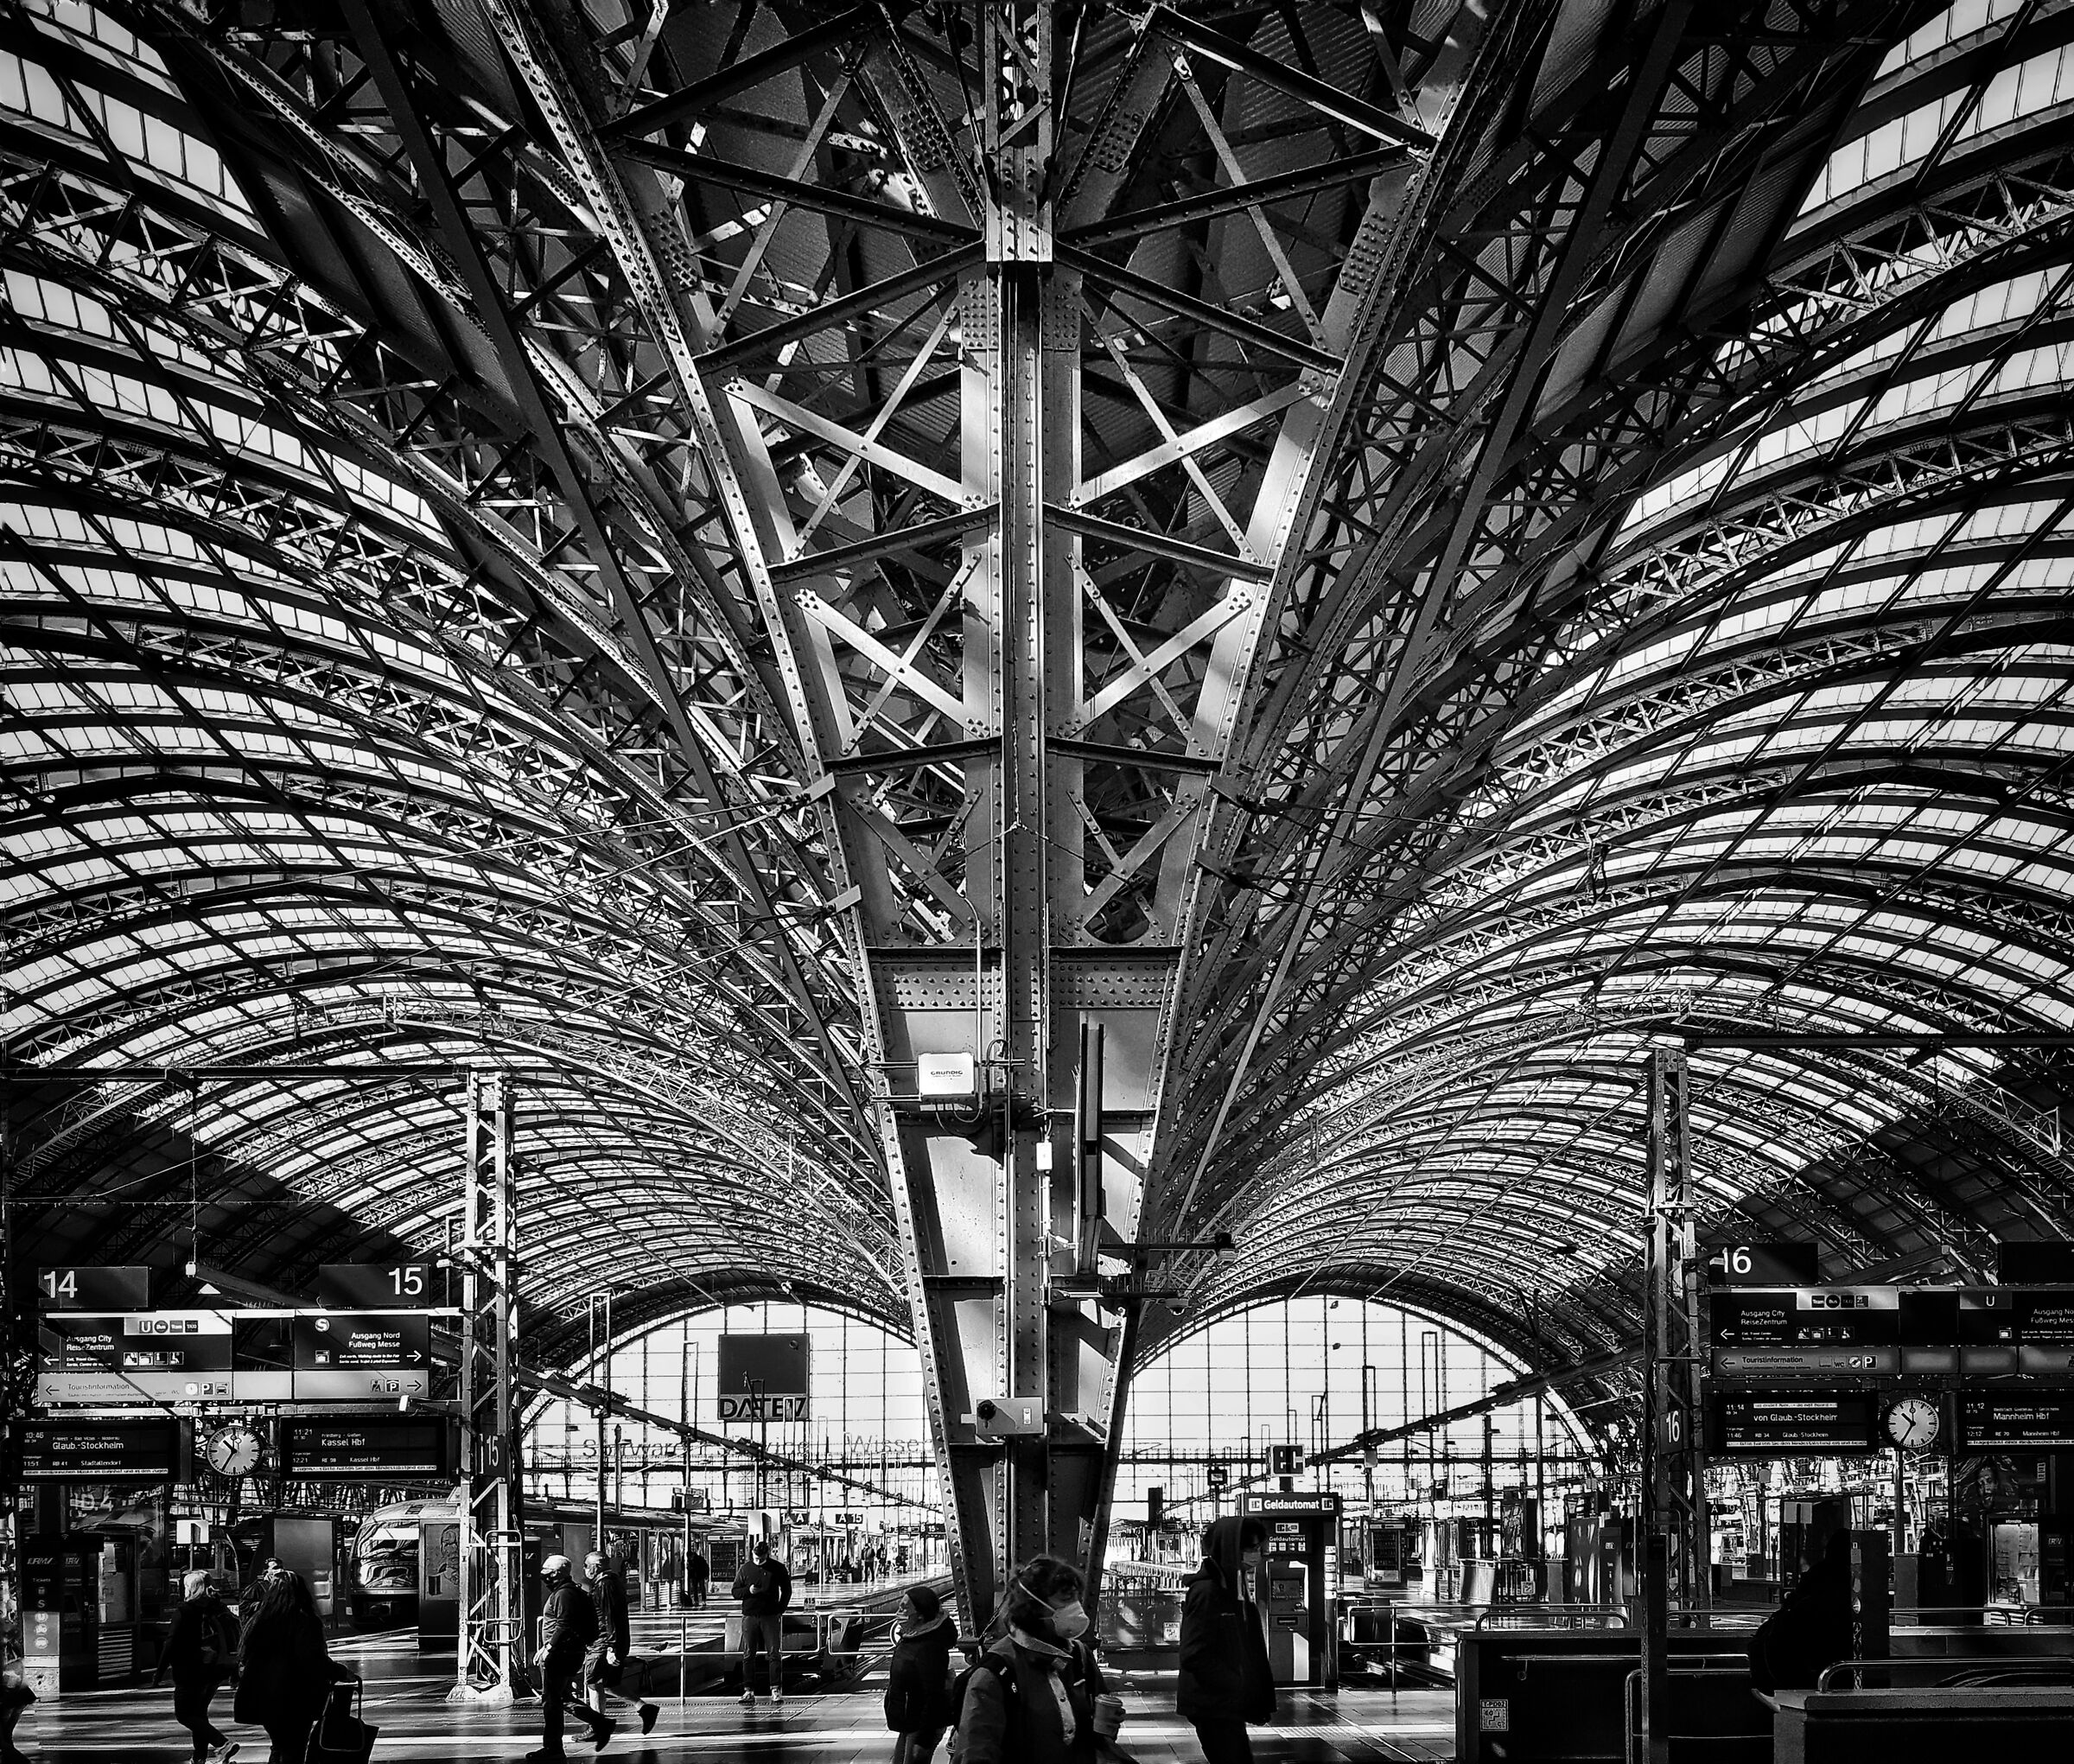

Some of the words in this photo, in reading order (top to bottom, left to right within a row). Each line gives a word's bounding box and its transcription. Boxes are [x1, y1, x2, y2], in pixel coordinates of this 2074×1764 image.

[1722, 1245, 1753, 1274] 16
[43, 1270, 79, 1298] 14
[388, 1266, 423, 1296] 15
[1986, 1296, 1995, 1307] U
[141, 1321, 151, 1333] U
[315, 1320, 328, 1331] S
[66, 1335, 97, 1344] Ausgang
[98, 1334, 112, 1343] City
[351, 1332, 382, 1341] Ausgang
[348, 1341, 377, 1349] Fußweg
[1864, 1356, 1873, 1367] P
[1665, 1410, 1680, 1443] 16
[52, 1442, 124, 1450] Glaub.-Stockheim
[486, 1435, 499, 1467] 15
[1263, 1500, 1320, 1510] Geldautomat
[796, 1513, 805, 1523] A
[838, 1513, 847, 1523] A
[851, 1513, 862, 1523] 15
[37, 1599, 46, 1608] S
